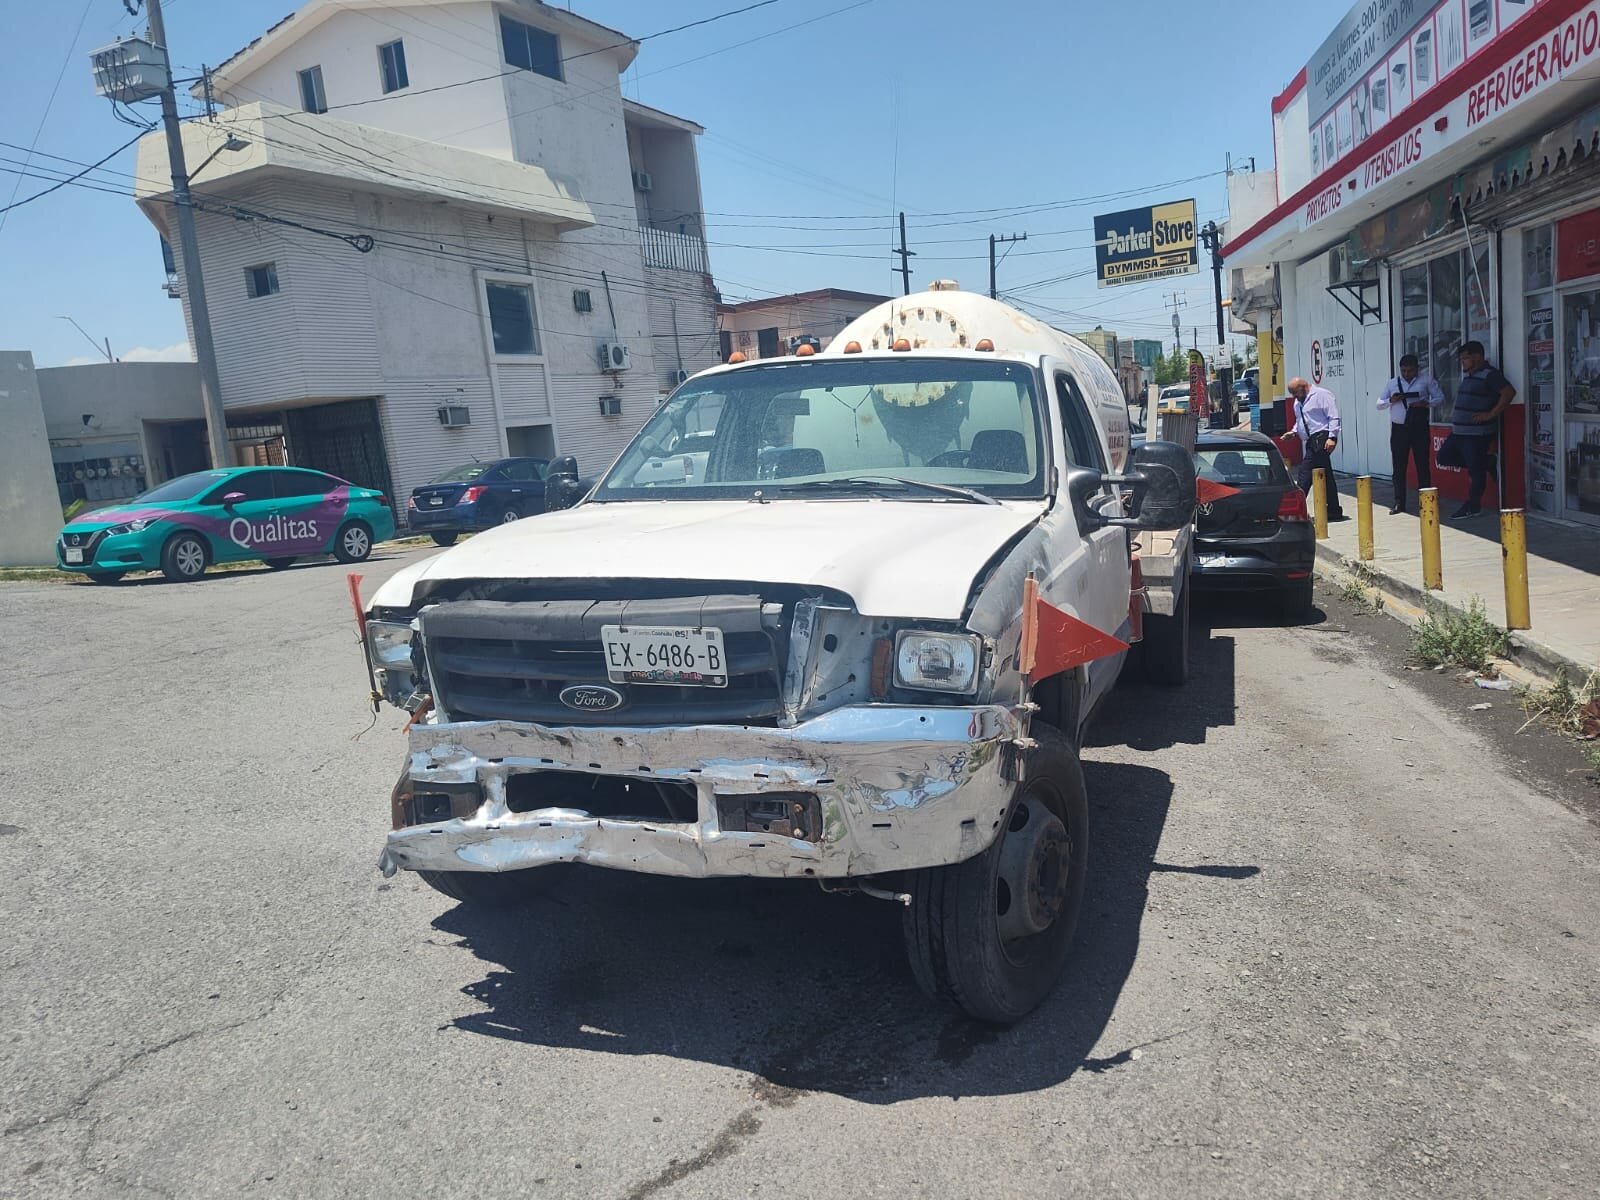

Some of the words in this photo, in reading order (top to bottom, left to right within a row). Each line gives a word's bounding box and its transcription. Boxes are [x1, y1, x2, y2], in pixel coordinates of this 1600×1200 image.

[1314, 58, 1332, 86] Lunes
[1336, 24, 1360, 60] Viernes
[1361, 1, 1377, 34] 9:00
[1363, 31, 1376, 63] AM
[1305, 183, 1342, 226] PROYECTOS
[1364, 127, 1422, 189] UTENSILIOS
[1467, 10, 1600, 128] REFRIGERACIO
[1106, 226, 1153, 256] Parker
[1154, 220, 1194, 247] Store
[1107, 258, 1159, 276] BYMMSA
[229, 514, 318, 549] Quálitas
[608, 642, 720, 670] EX-6486-B
[574, 690, 607, 707] Ford
